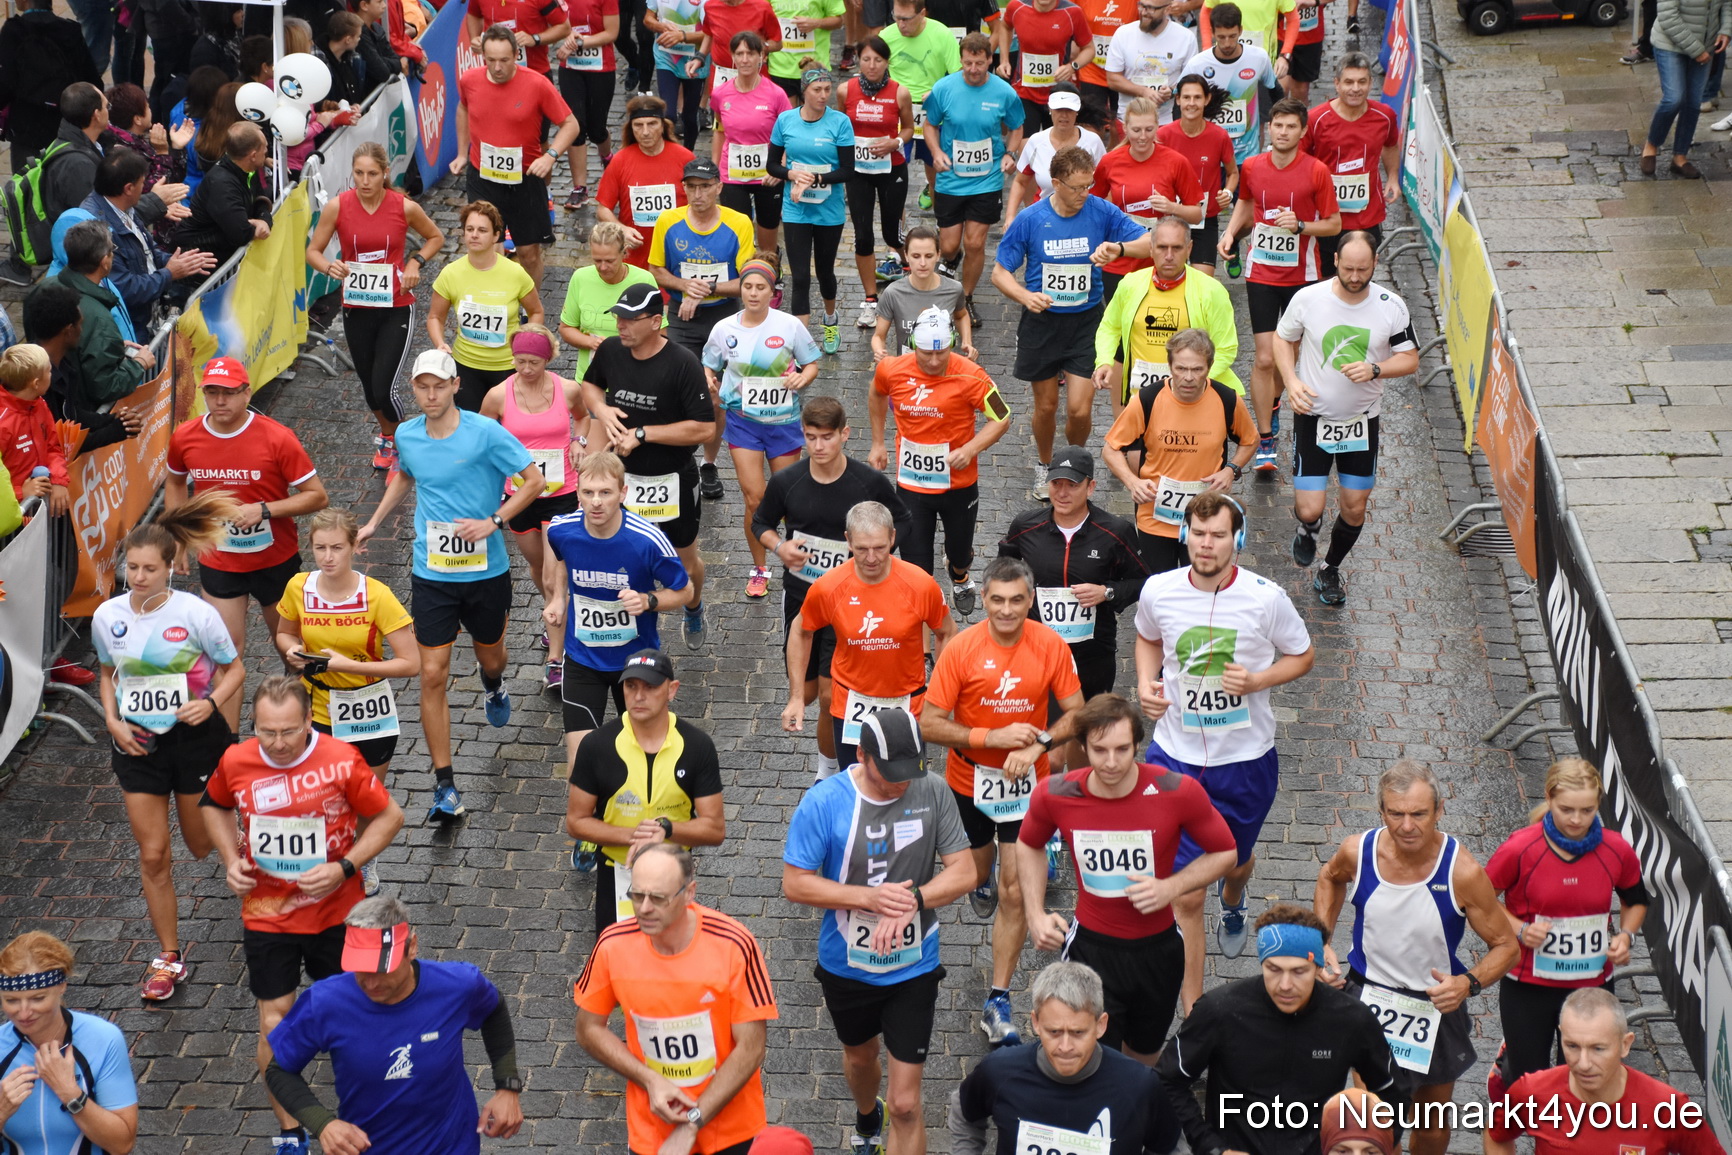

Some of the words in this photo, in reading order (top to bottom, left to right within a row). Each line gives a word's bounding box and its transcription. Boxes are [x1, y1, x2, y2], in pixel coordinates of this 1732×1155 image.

[785, 26, 807, 40] 214
[1029, 62, 1052, 75] 298
[736, 154, 761, 168] 189
[957, 148, 990, 163] 2795
[488, 155, 514, 170] 129
[635, 195, 672, 211] 2503
[1043, 238, 1089, 250] HUBER
[1258, 234, 1294, 251] 2126
[1265, 253, 1285, 261] Tobias
[350, 273, 389, 291] 2074
[1047, 274, 1087, 291] 2518
[348, 292, 365, 300] Anne
[365, 293, 388, 302] Sophie
[462, 313, 503, 332] 2217
[473, 332, 489, 341] Julia
[208, 368, 229, 376] DEKRA
[748, 388, 791, 406] 2407
[759, 408, 777, 418] Katja
[900, 403, 938, 412] funrunners
[1323, 421, 1363, 441] 2570
[1164, 435, 1198, 446] OEXL
[1336, 443, 1347, 451] Jan
[903, 451, 945, 472] 2695
[191, 469, 249, 479] NEUMARKT
[914, 474, 932, 482] Peter
[635, 486, 669, 503] 223
[639, 508, 664, 516] Helmut
[445, 559, 468, 567] Oliver
[572, 569, 629, 585] HUBER
[581, 608, 630, 628] 2050
[1043, 602, 1092, 622] 3074
[303, 616, 331, 626] MAX
[335, 615, 370, 627] BÖGL
[590, 632, 622, 642] Thomas
[847, 637, 893, 645] funrunners
[861, 643, 900, 651] neumarkt
[129, 690, 183, 713] 3064
[980, 697, 1028, 706] funrunners
[1186, 690, 1242, 711] 2450
[338, 695, 391, 721] 2690
[993, 704, 1034, 712] neumarkt
[1203, 716, 1226, 725] Marc
[350, 723, 381, 733] Marina
[994, 804, 1022, 814] Robert
[258, 832, 317, 856] 2101
[276, 860, 301, 872] Hans
[1083, 848, 1147, 872] 3046
[856, 922, 915, 949] 29
[1543, 930, 1603, 956] 2519
[869, 954, 900, 965] Rudolf
[1555, 961, 1590, 972] Marina
[649, 1034, 699, 1060] 160
[661, 1066, 692, 1078] Alfred
